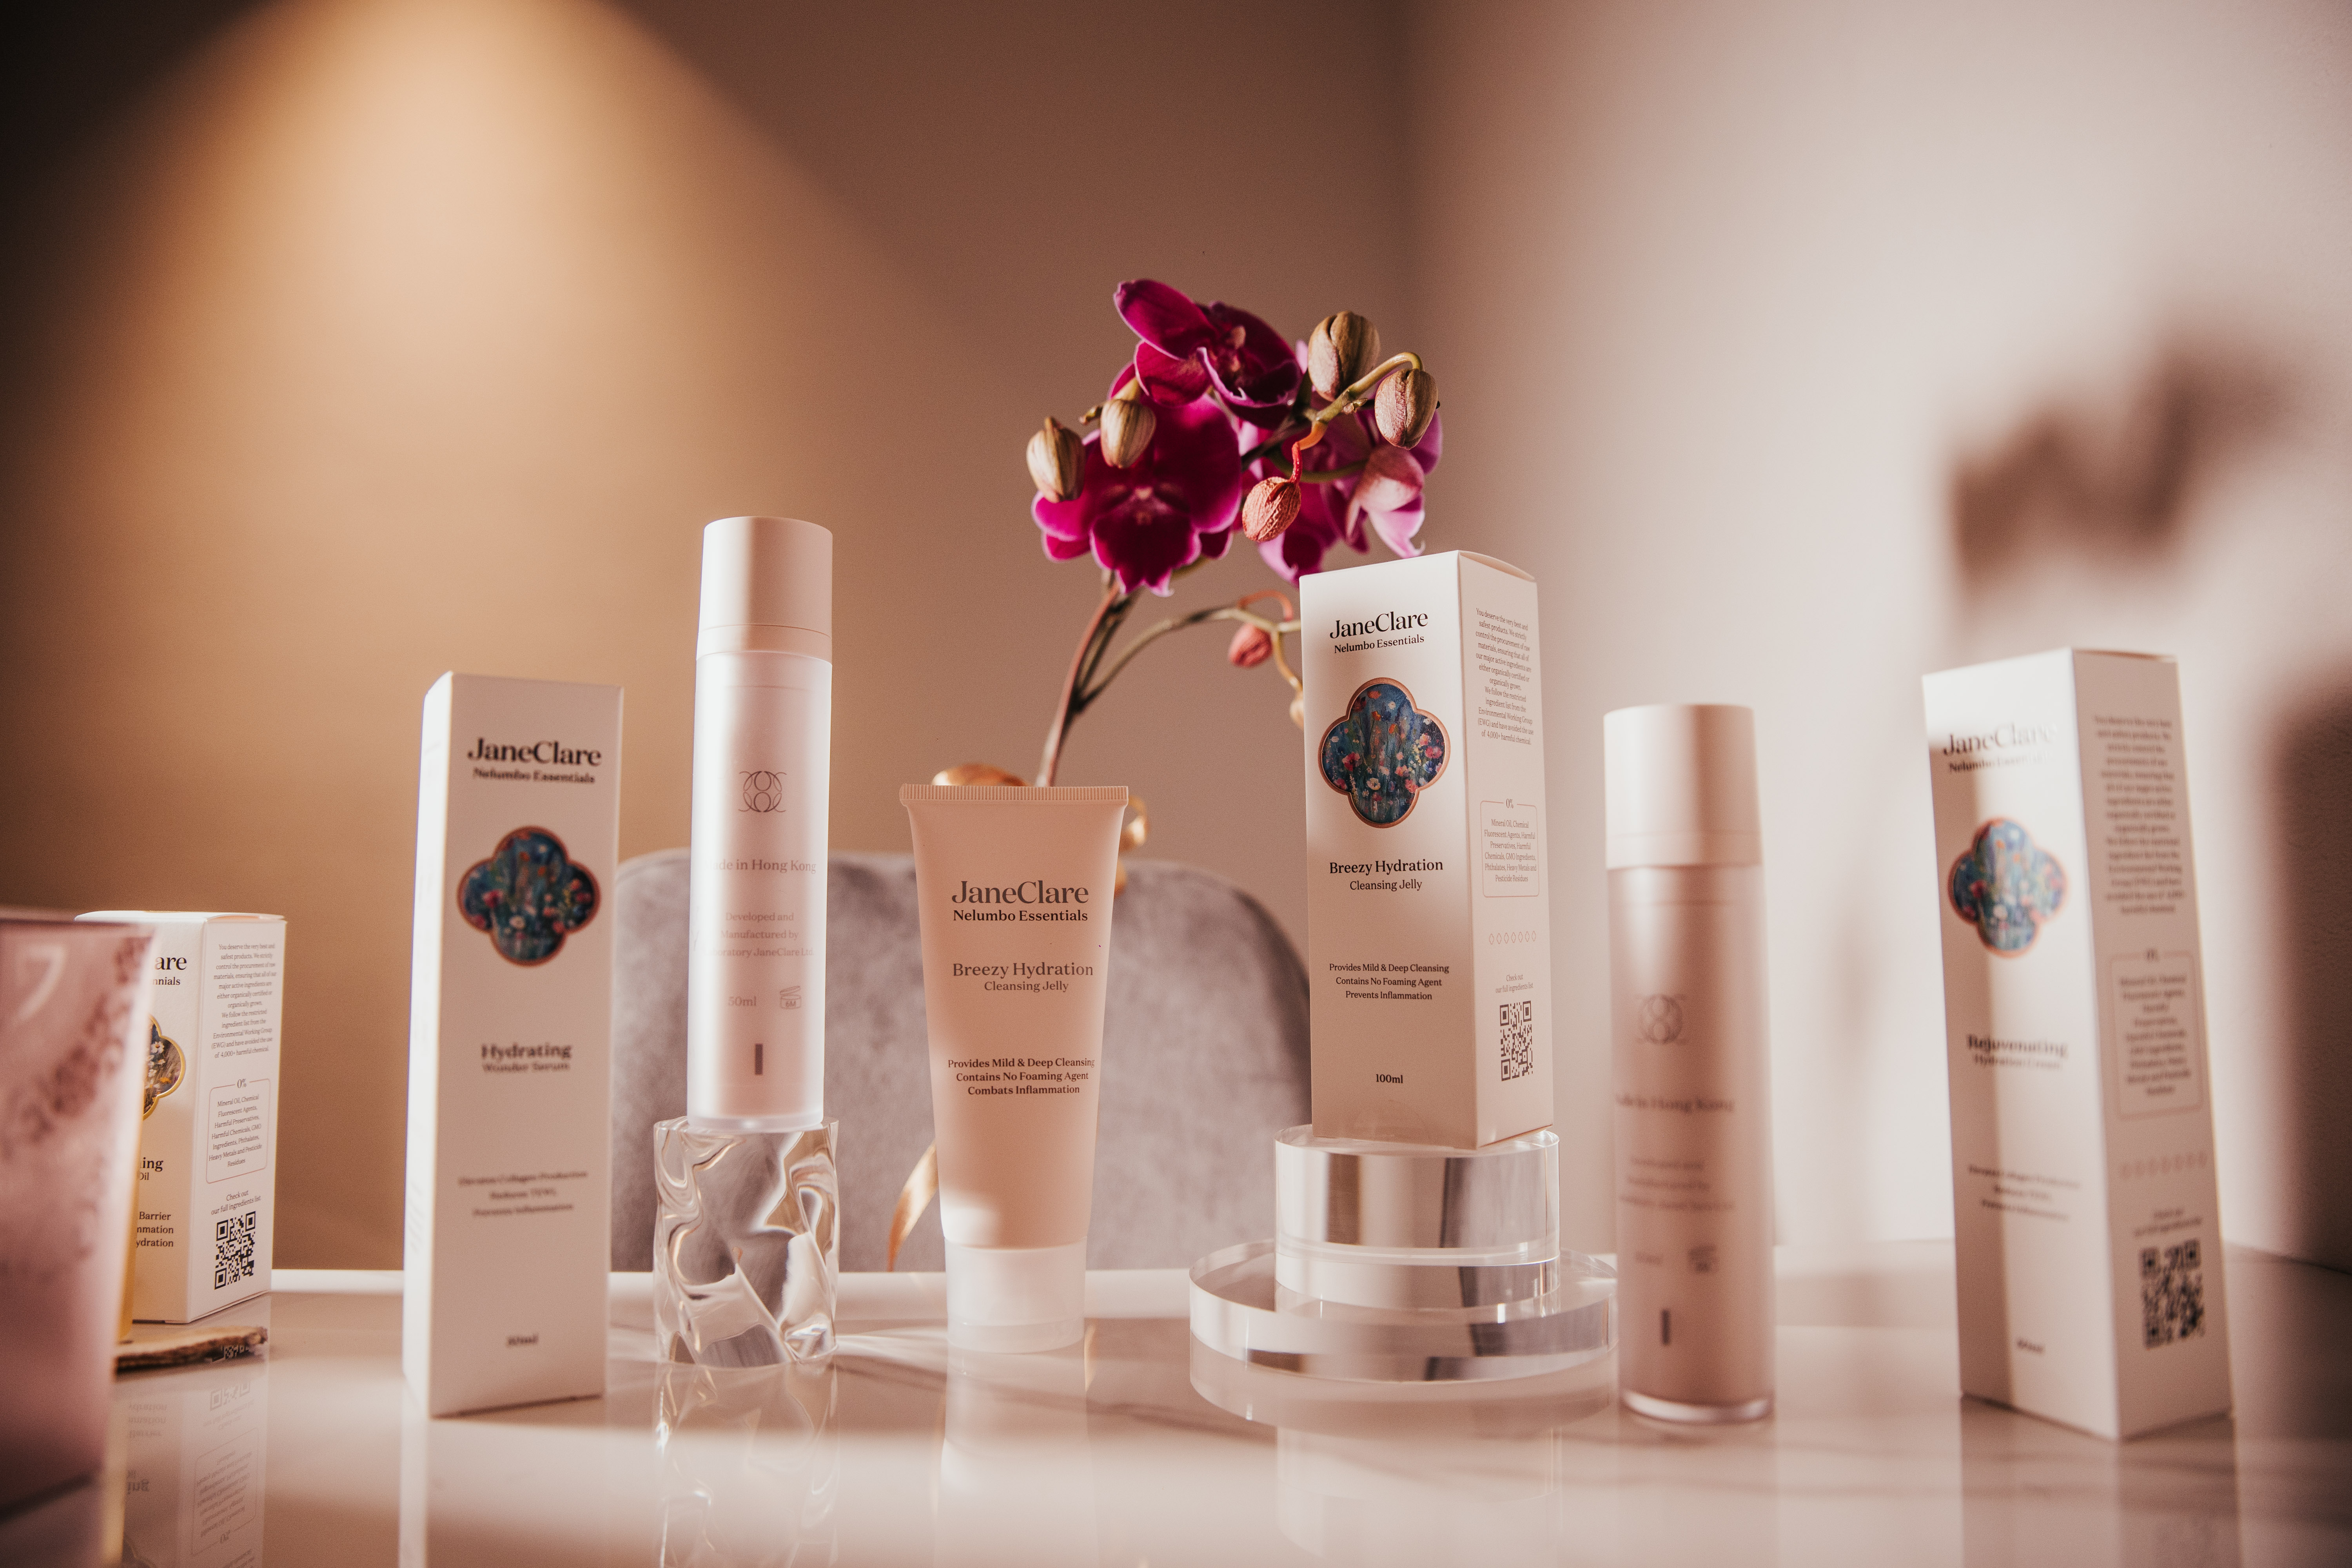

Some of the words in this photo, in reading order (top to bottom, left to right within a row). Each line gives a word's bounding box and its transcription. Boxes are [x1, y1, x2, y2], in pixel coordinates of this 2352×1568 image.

[1485, 610, 1499, 621] deserve
[1330, 611, 1428, 639] JaneClare
[1479, 621, 1490, 629] safest
[1492, 625, 1508, 634] products.
[1515, 632, 1526, 642] strictly
[1334, 641, 1375, 653] Nelumbo
[1377, 634, 1424, 648] Essentials
[1475, 631, 1490, 639] control
[1497, 637, 1520, 647] procurement
[1490, 679, 1509, 689] organically
[1492, 688, 1502, 696] follow
[1510, 694, 1526, 702] restricted
[1486, 697, 1505, 708] ingredient
[1479, 707, 1506, 719] Environmental
[1507, 713, 1521, 723] Working
[1522, 716, 1532, 726] Group
[1478, 718, 1490, 727] (EWG)
[1501, 733, 1515, 742] harmful
[467, 737, 602, 766] JaneClare
[1506, 799, 1514, 808] 0%
[1485, 829, 1507, 838] Fluorescent
[1490, 841, 1516, 849] Preservatives,
[1485, 852, 1505, 860] Chemicals,
[1516, 853, 1536, 862] Ingredients,
[737, 859, 748, 870] in
[752, 860, 788, 873] Hong
[790, 860, 817, 874] Kong
[1330, 862, 1372, 875] Breezy
[1376, 859, 1443, 875] Hydration
[1485, 863, 1506, 871] Phthalates,
[1507, 864, 1518, 872] Heavy
[1350, 880, 1397, 891] Cleansing
[1399, 879, 1422, 891] Jelly
[951, 880, 1089, 904] JaneClare
[726, 912, 775, 923] Developed
[778, 913, 794, 921] and
[953, 909, 1016, 922] Nelumbo
[1019, 909, 1088, 922] Essentials
[721, 930, 786, 938] Manufactured
[789, 930, 799, 940] by
[706, 948, 752, 958] boratory
[753, 948, 800, 956] JaneClare
[953, 963, 1009, 979] Breezy
[1013, 962, 1093, 979] Hydration
[1388, 964, 1408, 973] Deep
[1410, 964, 1449, 974] Cleansing
[152, 977, 180, 985] nnials
[1383, 978, 1416, 987] Foaming
[1418, 978, 1442, 987] Agent
[984, 981, 1040, 993] Cleansing
[1043, 981, 1069, 993] Jelly
[1509, 983, 1528, 993] ingredients
[728, 996, 757, 1006] 50ml
[1380, 991, 1432, 1000] Inflammation
[481, 1042, 572, 1063] Hydrating
[948, 1058, 990, 1069] Provides
[992, 1058, 1015, 1068] Mild
[1017, 1058, 1025, 1068] &
[1027, 1058, 1053, 1070] Deep
[1055, 1058, 1095, 1069] Cleansing
[956, 1072, 1001, 1082] Contains
[1002, 1072, 1017, 1081] No
[1019, 1072, 1063, 1083] Foaming
[1064, 1072, 1089, 1082] Agent
[1376, 1074, 1403, 1083] 100ml
[967, 1086, 1013, 1095] Combats
[1015, 1085, 1080, 1094] Inflammation
[218, 1099, 233, 1107] Mineral
[241, 1094, 259, 1102] Chemical
[218, 1109, 242, 1117] Fluorescent
[243, 1105, 257, 1114] Agents,
[214, 1119, 232, 1129] Harmful
[233, 1115, 259, 1125] Preservatives,
[212, 1130, 229, 1140] Harmful
[230, 1126, 250, 1136] Chemicals,
[213, 1140, 238, 1151] Ingredients,
[238, 1135, 259, 1144] Phthalates,
[223, 1149, 237, 1158] Metals
[245, 1143, 262, 1153] Pesticide
[228, 1158, 245, 1167] Residues
[226, 1192, 240, 1201] Check
[229, 1198, 254, 1210] ingredients
[139, 1211, 171, 1220] Barrier
[137, 1225, 174, 1234] mmation
[136, 1238, 174, 1248] ydration
